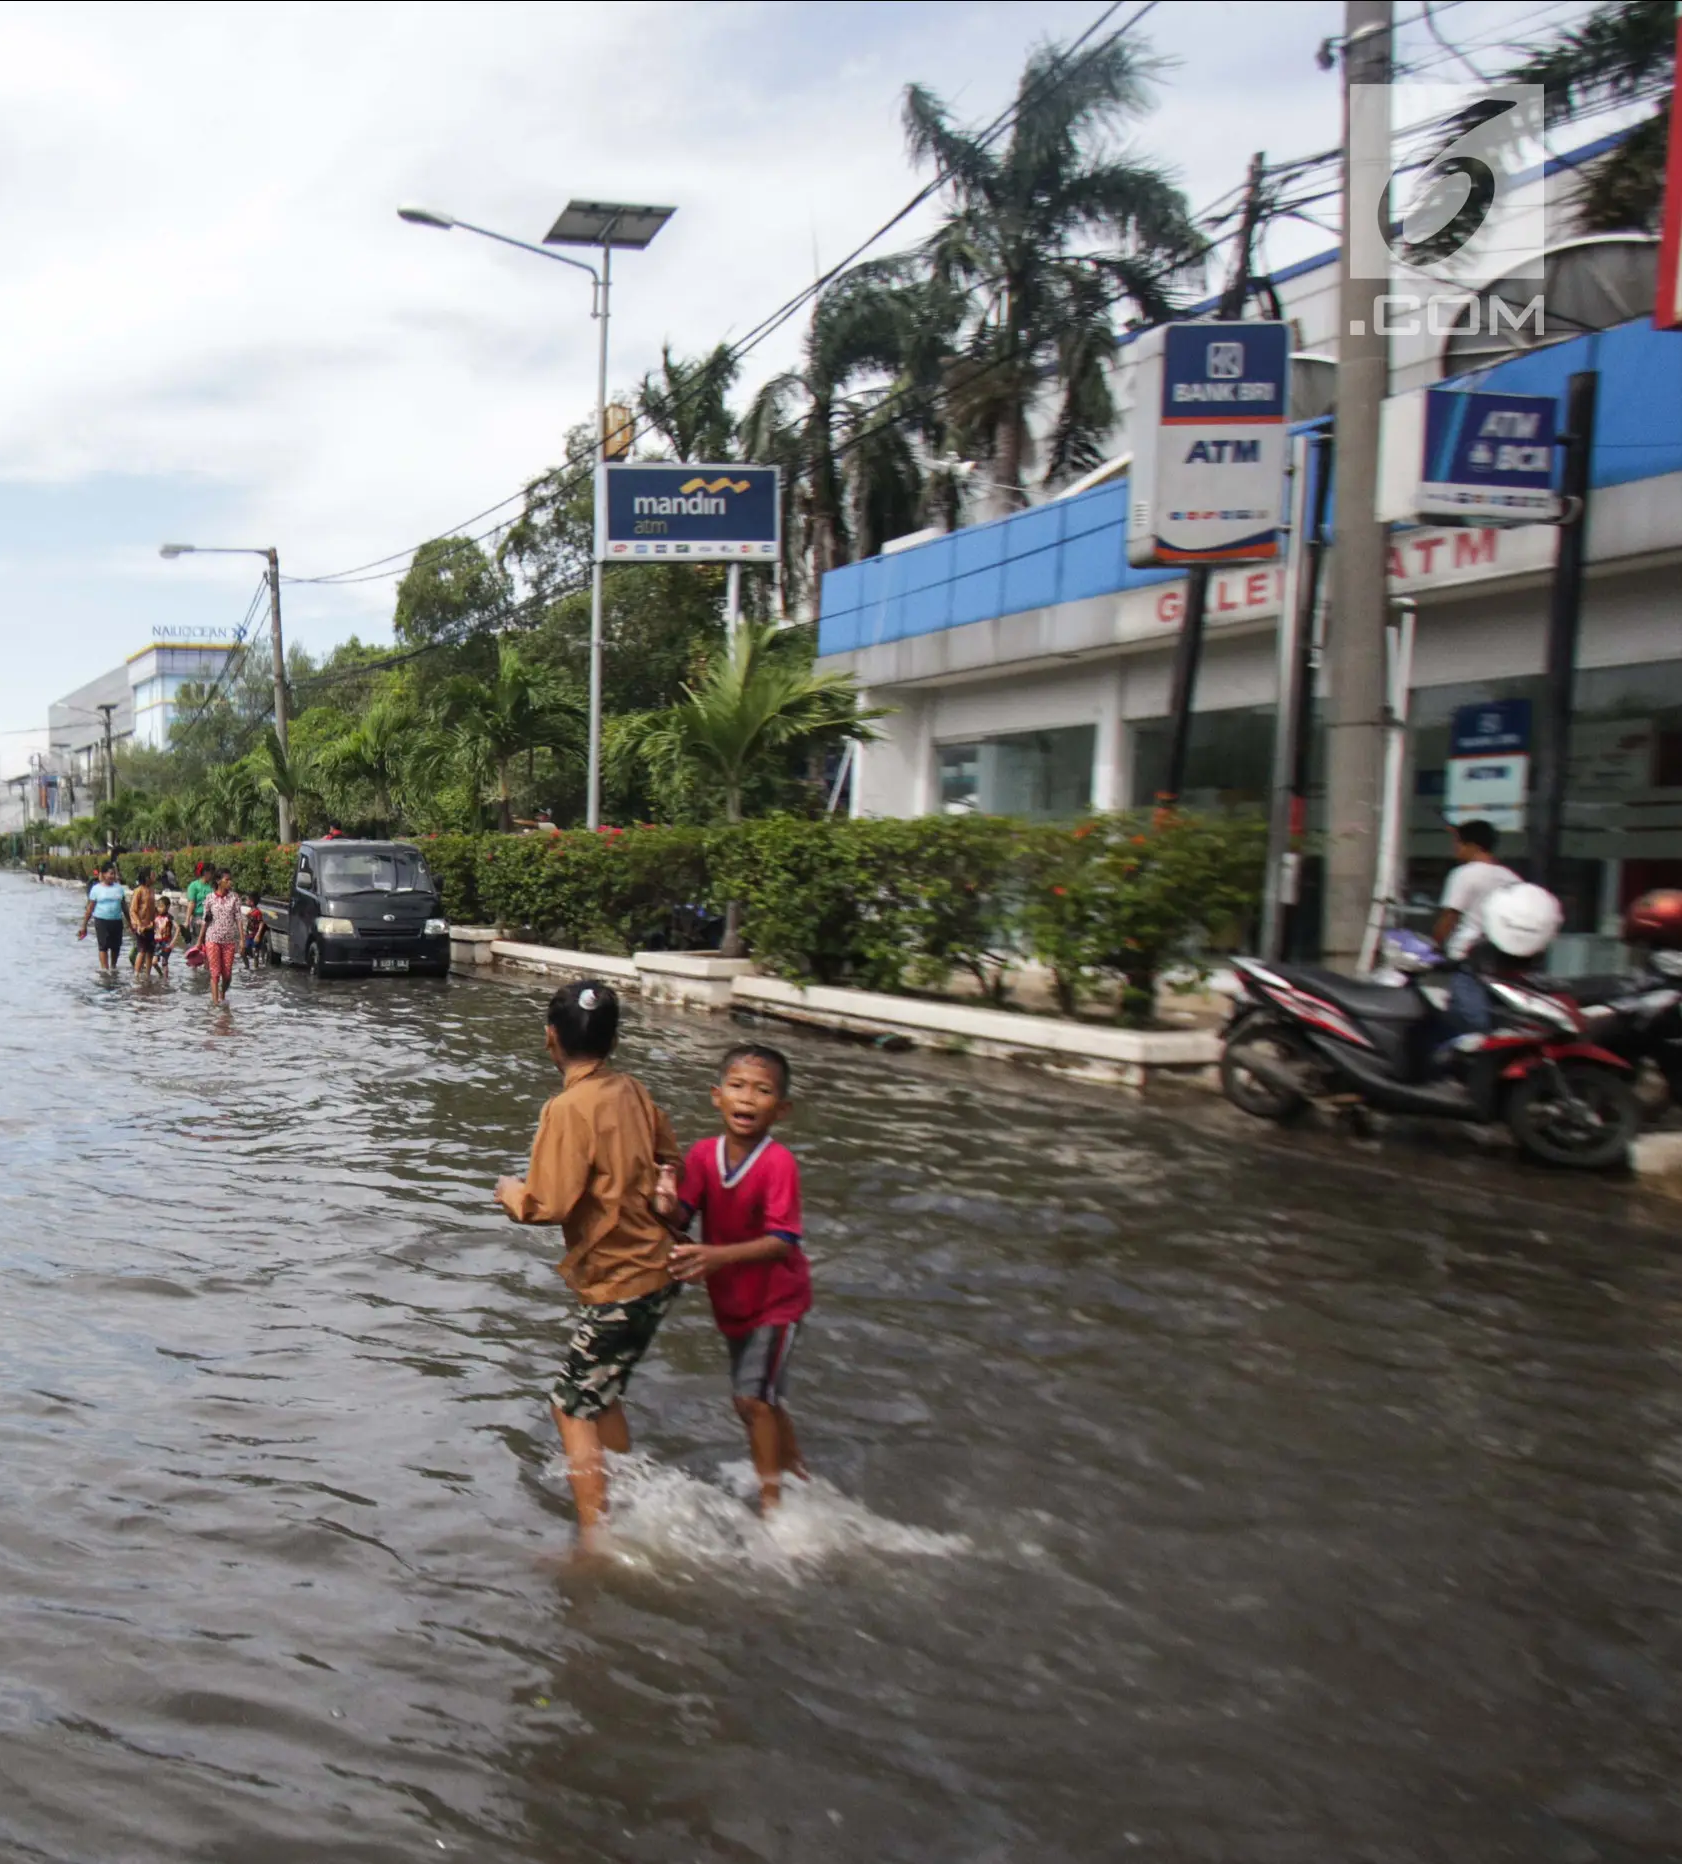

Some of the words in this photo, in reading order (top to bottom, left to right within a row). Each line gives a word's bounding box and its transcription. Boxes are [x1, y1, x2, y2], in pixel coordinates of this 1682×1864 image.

[1172, 383, 1236, 402] BANK
[1238, 382, 1276, 401] BRI
[1478, 410, 1541, 439] ATM
[1184, 440, 1261, 464] ATM
[1495, 445, 1550, 472] BCA
[633, 491, 726, 515] mandiri
[634, 519, 667, 534] atm
